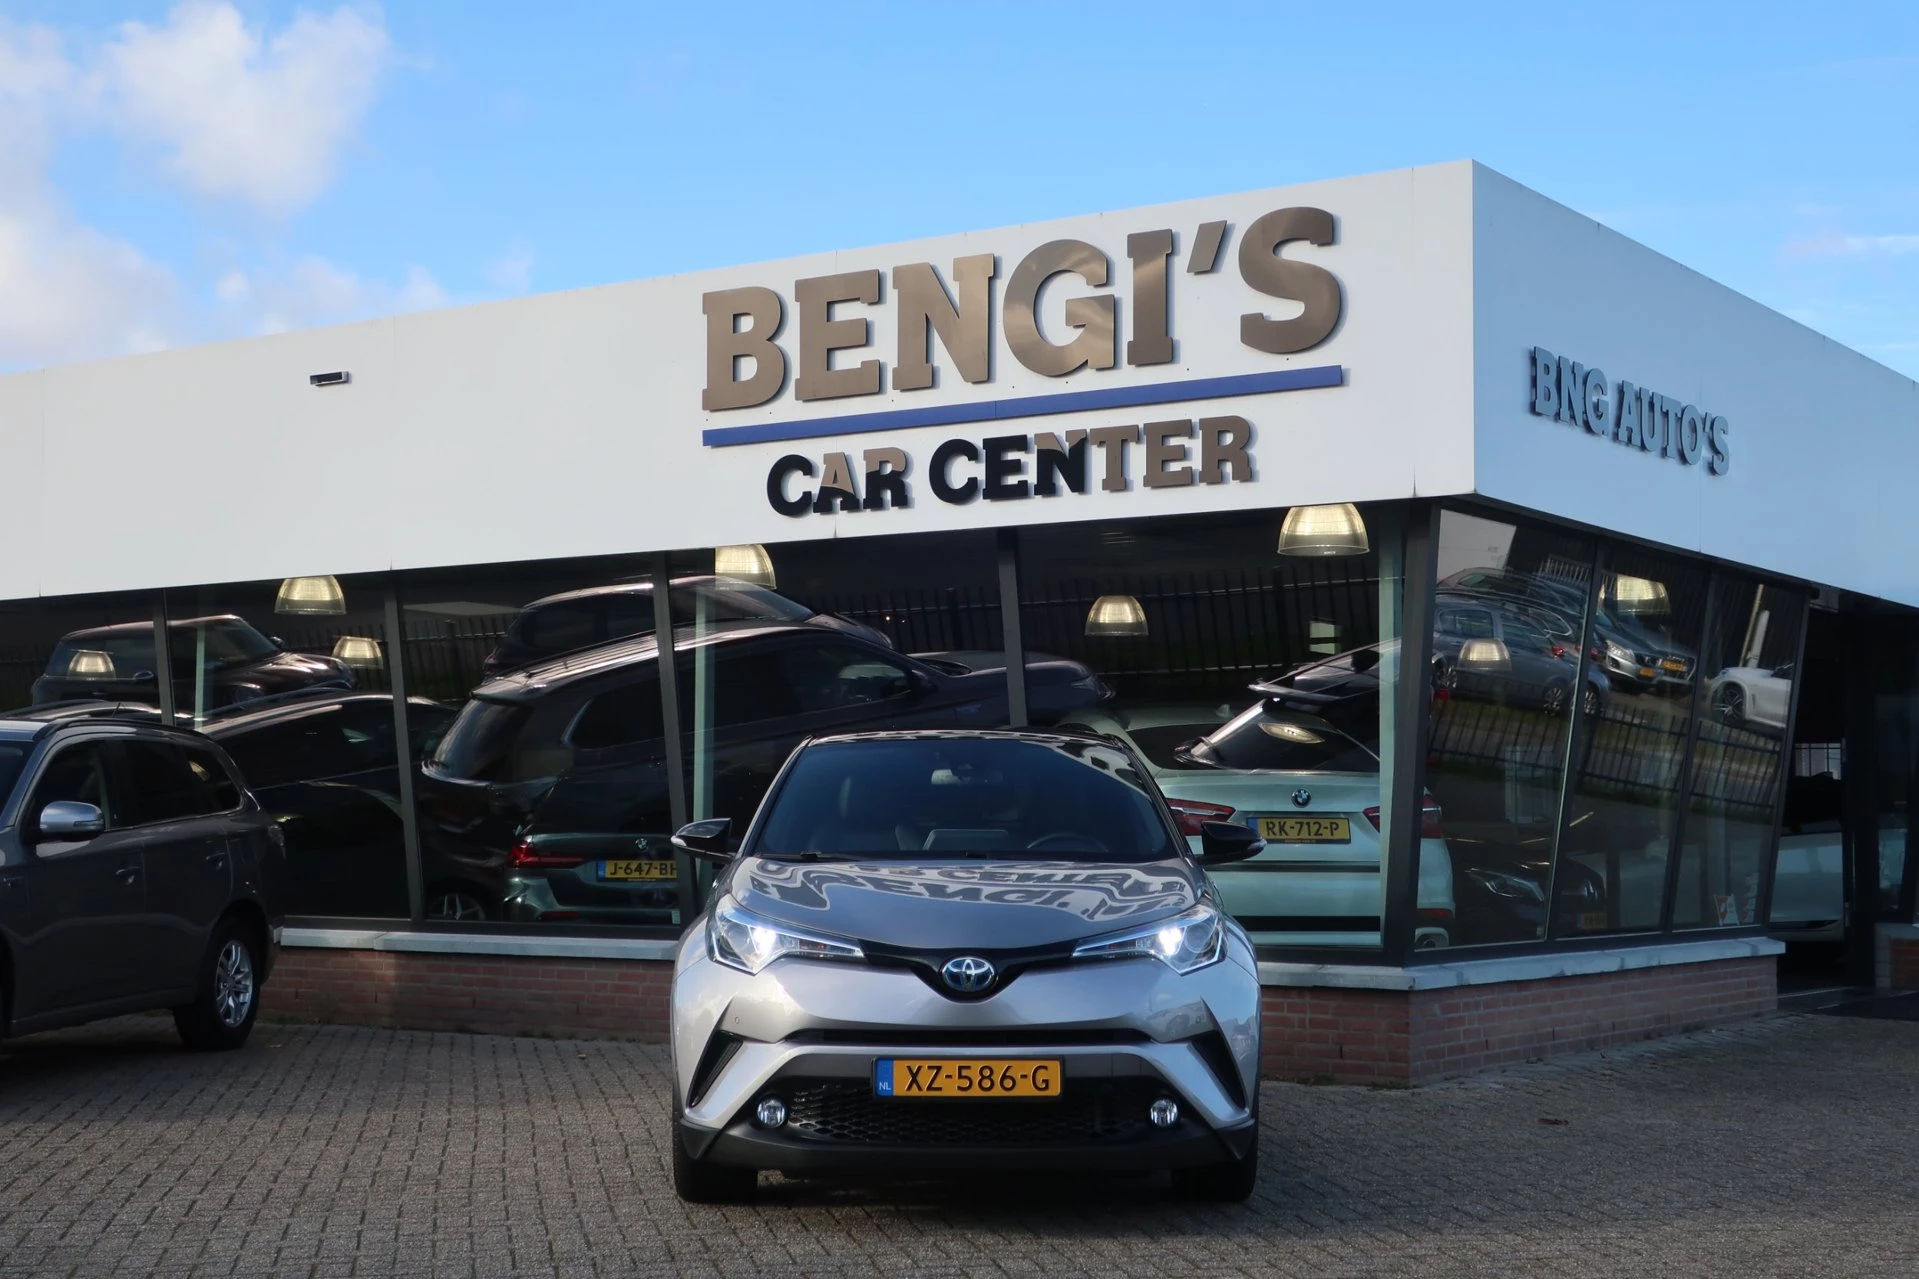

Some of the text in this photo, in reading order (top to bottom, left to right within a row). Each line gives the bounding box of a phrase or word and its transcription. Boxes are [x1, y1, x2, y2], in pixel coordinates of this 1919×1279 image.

[702, 206, 1342, 412] BENGI'S
[1531, 346, 1730, 477] BNG AUTO'S
[767, 415, 1253, 518] CAR CENTER
[1265, 821, 1340, 837] RK-712-P
[878, 1082, 892, 1091] NL
[905, 1064, 1050, 1092] XZ-586-G
